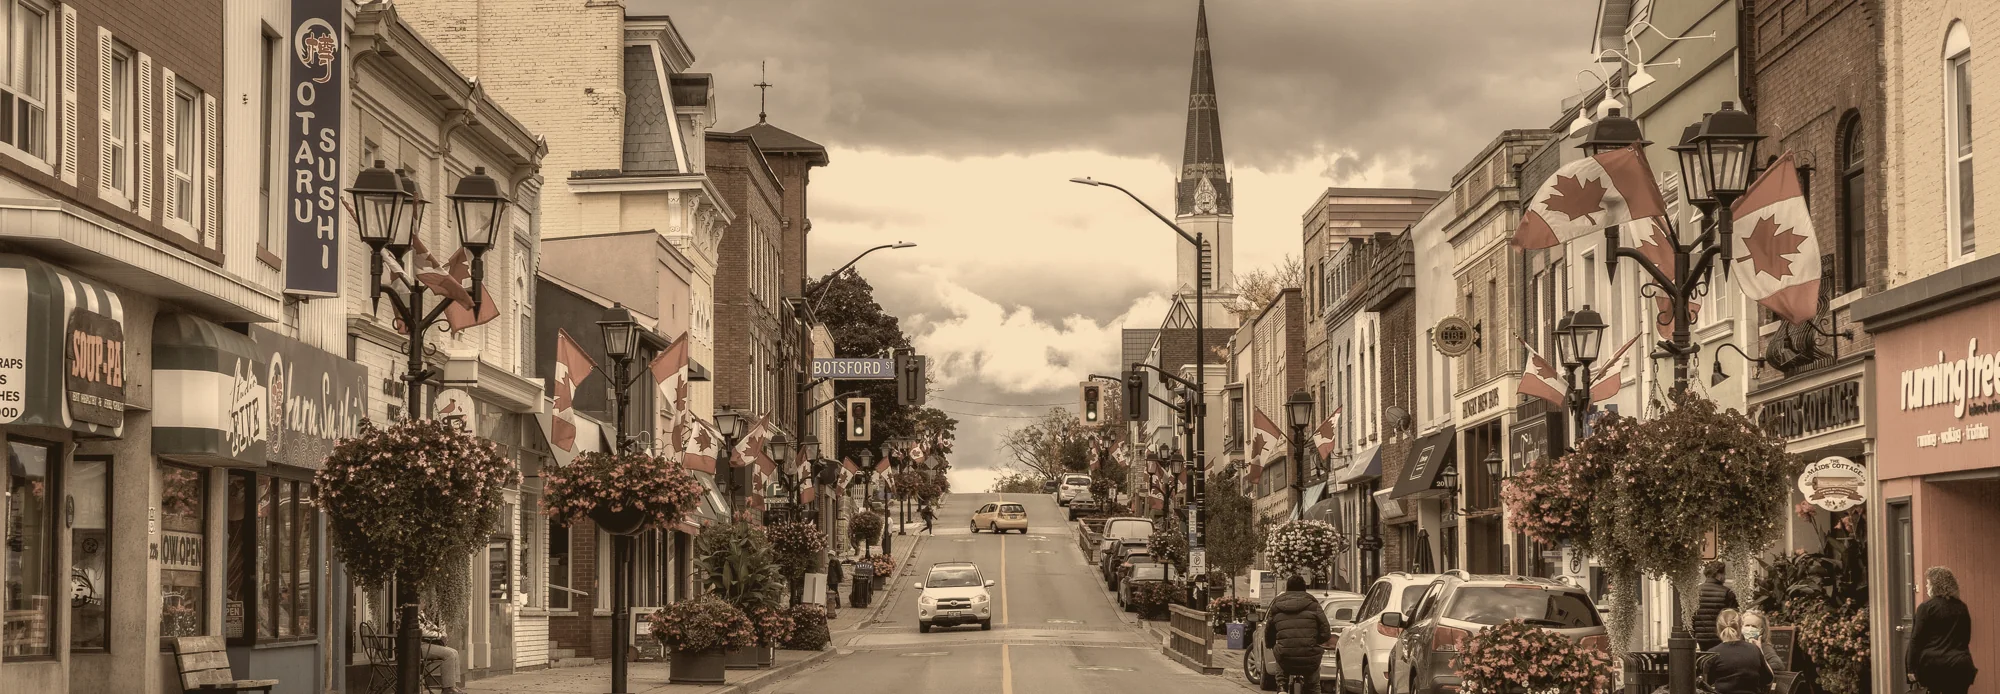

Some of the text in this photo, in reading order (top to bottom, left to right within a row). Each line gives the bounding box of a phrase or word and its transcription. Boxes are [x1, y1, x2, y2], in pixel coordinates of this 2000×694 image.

[294, 82, 316, 224] OTARU
[316, 127, 336, 270] SUSHI
[813, 360, 894, 375] BOTSFORD ST
[1801, 381, 1859, 432] COTTAGE
[1832, 463, 1863, 475] COTTAGE
[179, 536, 202, 567] OPEN
